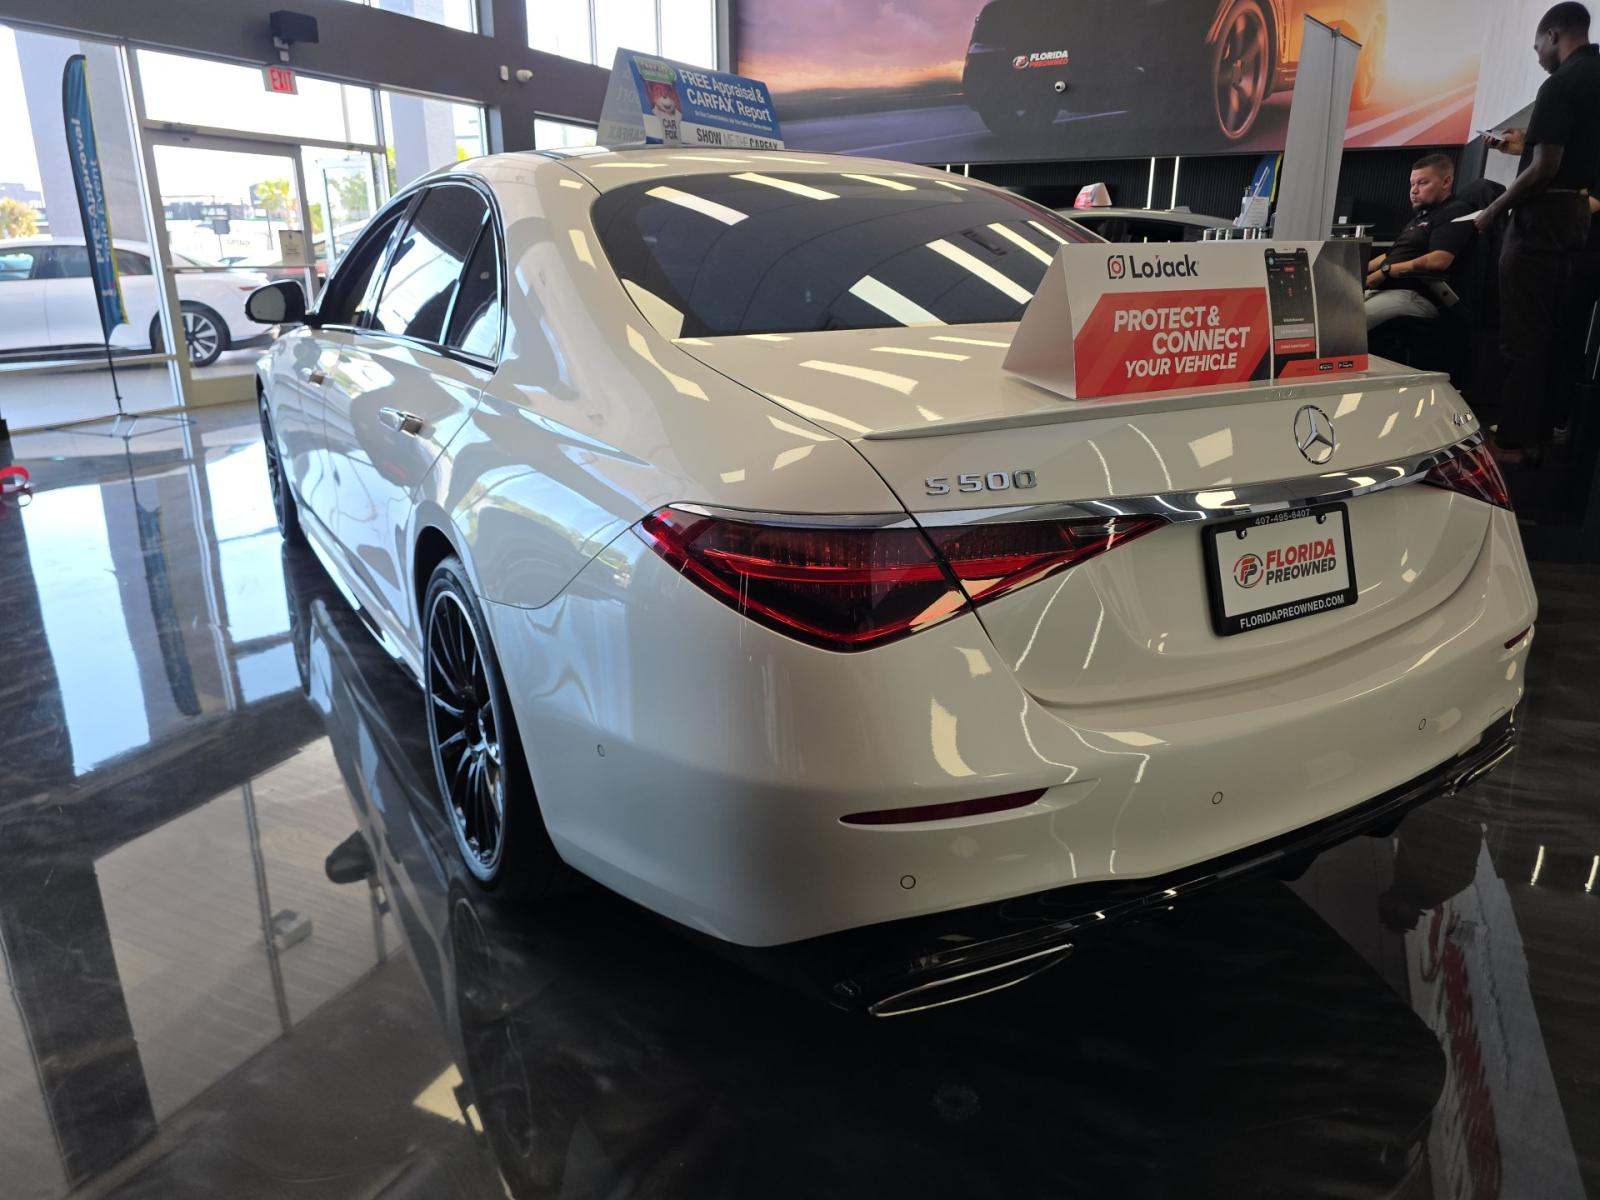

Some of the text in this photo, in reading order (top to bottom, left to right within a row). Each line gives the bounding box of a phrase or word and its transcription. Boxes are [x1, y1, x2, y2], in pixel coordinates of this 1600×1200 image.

[1030, 50, 1069, 62] FLORIDA
[269, 68, 293, 92] EXIT
[679, 69, 765, 103] FREE Appraisal &
[687, 88, 733, 113] CARFAX
[737, 101, 772, 122] Report
[662, 118, 676, 129] CAR
[665, 129, 677, 140] FOX
[696, 128, 722, 145] SHOW
[71, 117, 104, 263] Pre-Approval
[1114, 305, 1220, 332] PROTECT &
[1152, 326, 1251, 355] CONNECT
[1125, 351, 1237, 378] YOUR VEHICLE
[925, 470, 1038, 495] S 500
[1265, 538, 1336, 570] FLORIDA
[1266, 557, 1337, 586] PREOWNED
[1240, 594, 1345, 629] FLORIDAPREOWNED.COM
